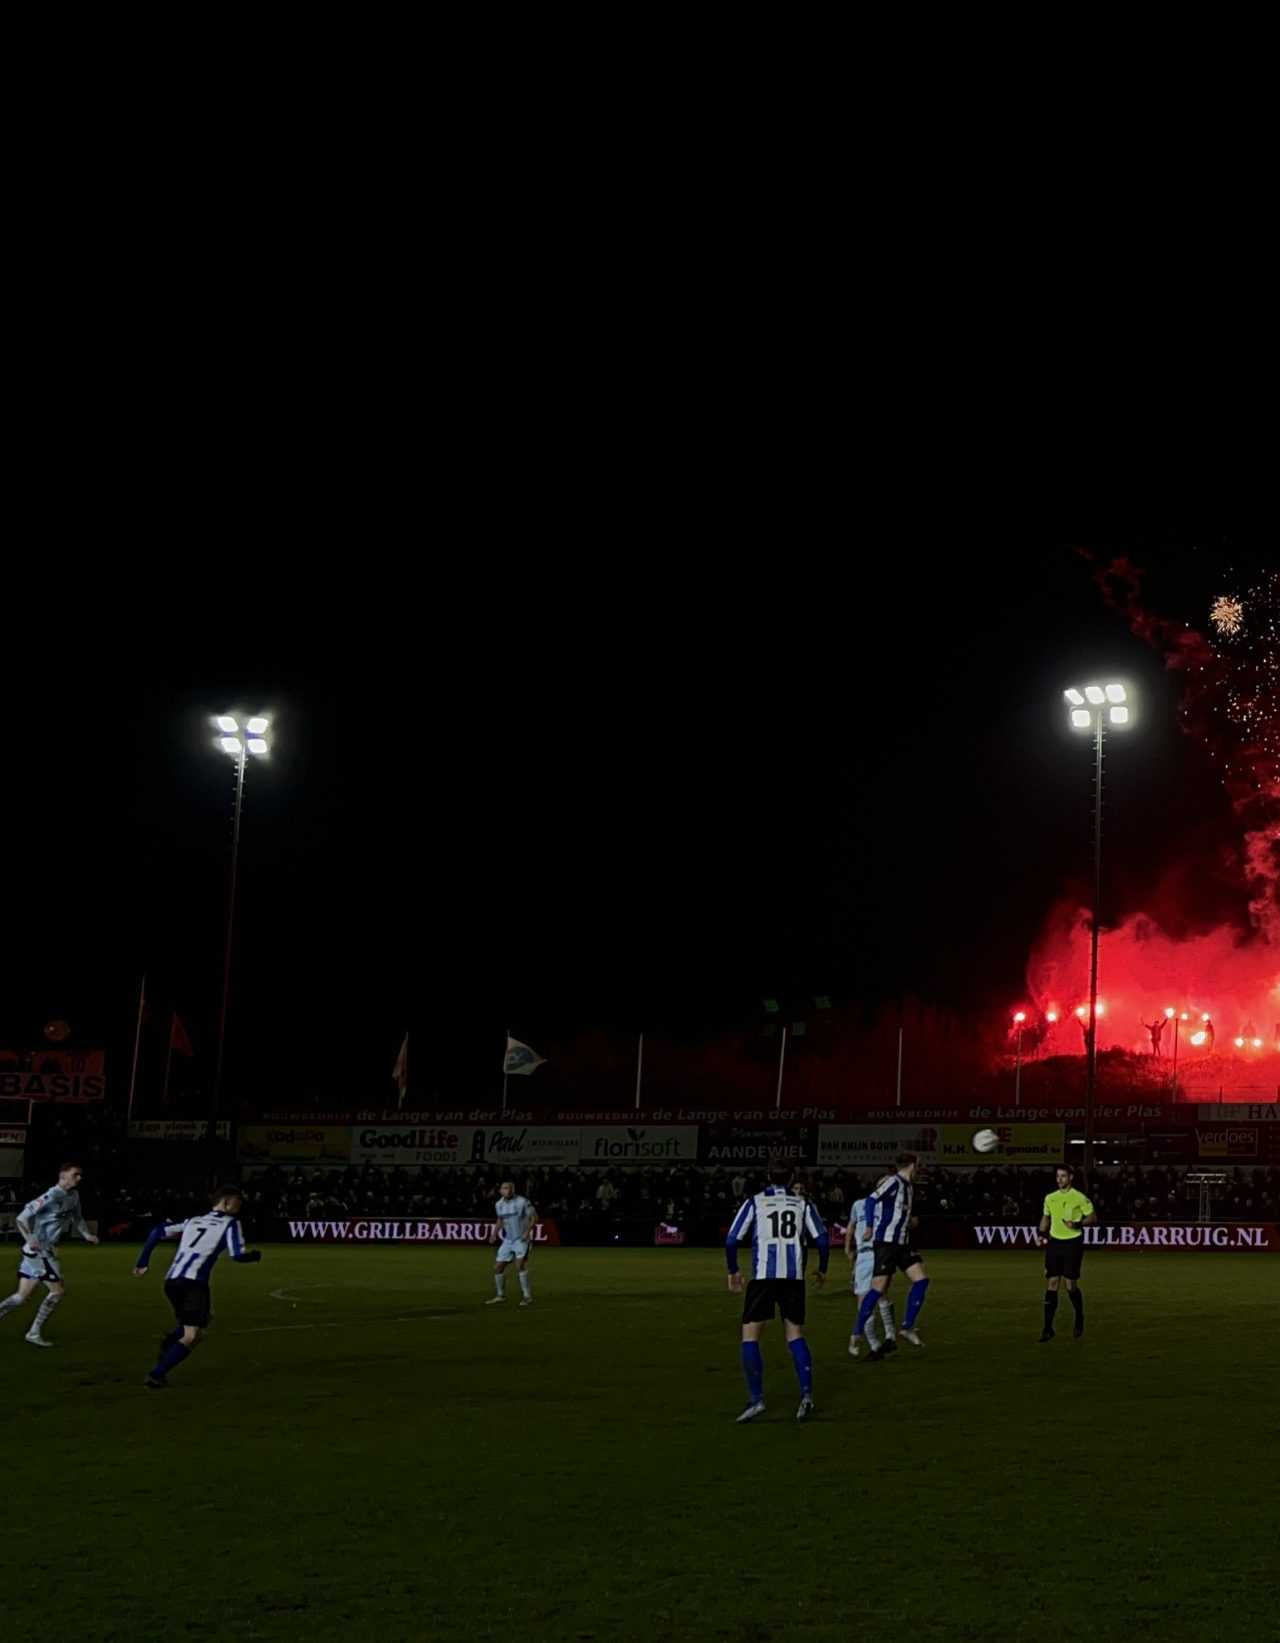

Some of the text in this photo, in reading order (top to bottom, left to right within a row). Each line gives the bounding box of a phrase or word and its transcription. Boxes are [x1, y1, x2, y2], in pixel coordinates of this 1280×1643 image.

[0, 1074, 102, 1097] BASIS
[356, 1109, 377, 1121] de
[381, 1109, 430, 1124] Lange
[435, 1111, 466, 1121] van
[468, 1109, 496, 1121] der
[499, 1109, 534, 1121] Plas
[652, 1107, 673, 1121] de
[677, 1107, 728, 1124] Lange
[732, 1109, 763, 1120] van
[767, 1106, 799, 1120] der
[801, 1105, 837, 1120] Plas
[968, 1104, 993, 1119] de
[996, 1104, 1049, 1122] Lange
[1055, 1106, 1086, 1119] van
[1093, 1104, 1124, 1119] der
[1127, 1103, 1163, 1119] Plas
[594, 1137, 681, 1157] florisoft
[707, 1144, 809, 1159] AANDEWIEL
[767, 1210, 796, 1239] 18
[189, 1228, 207, 1248] 7
[974, 1226, 1269, 1246] WWW.ILLBARRUIG.NL
